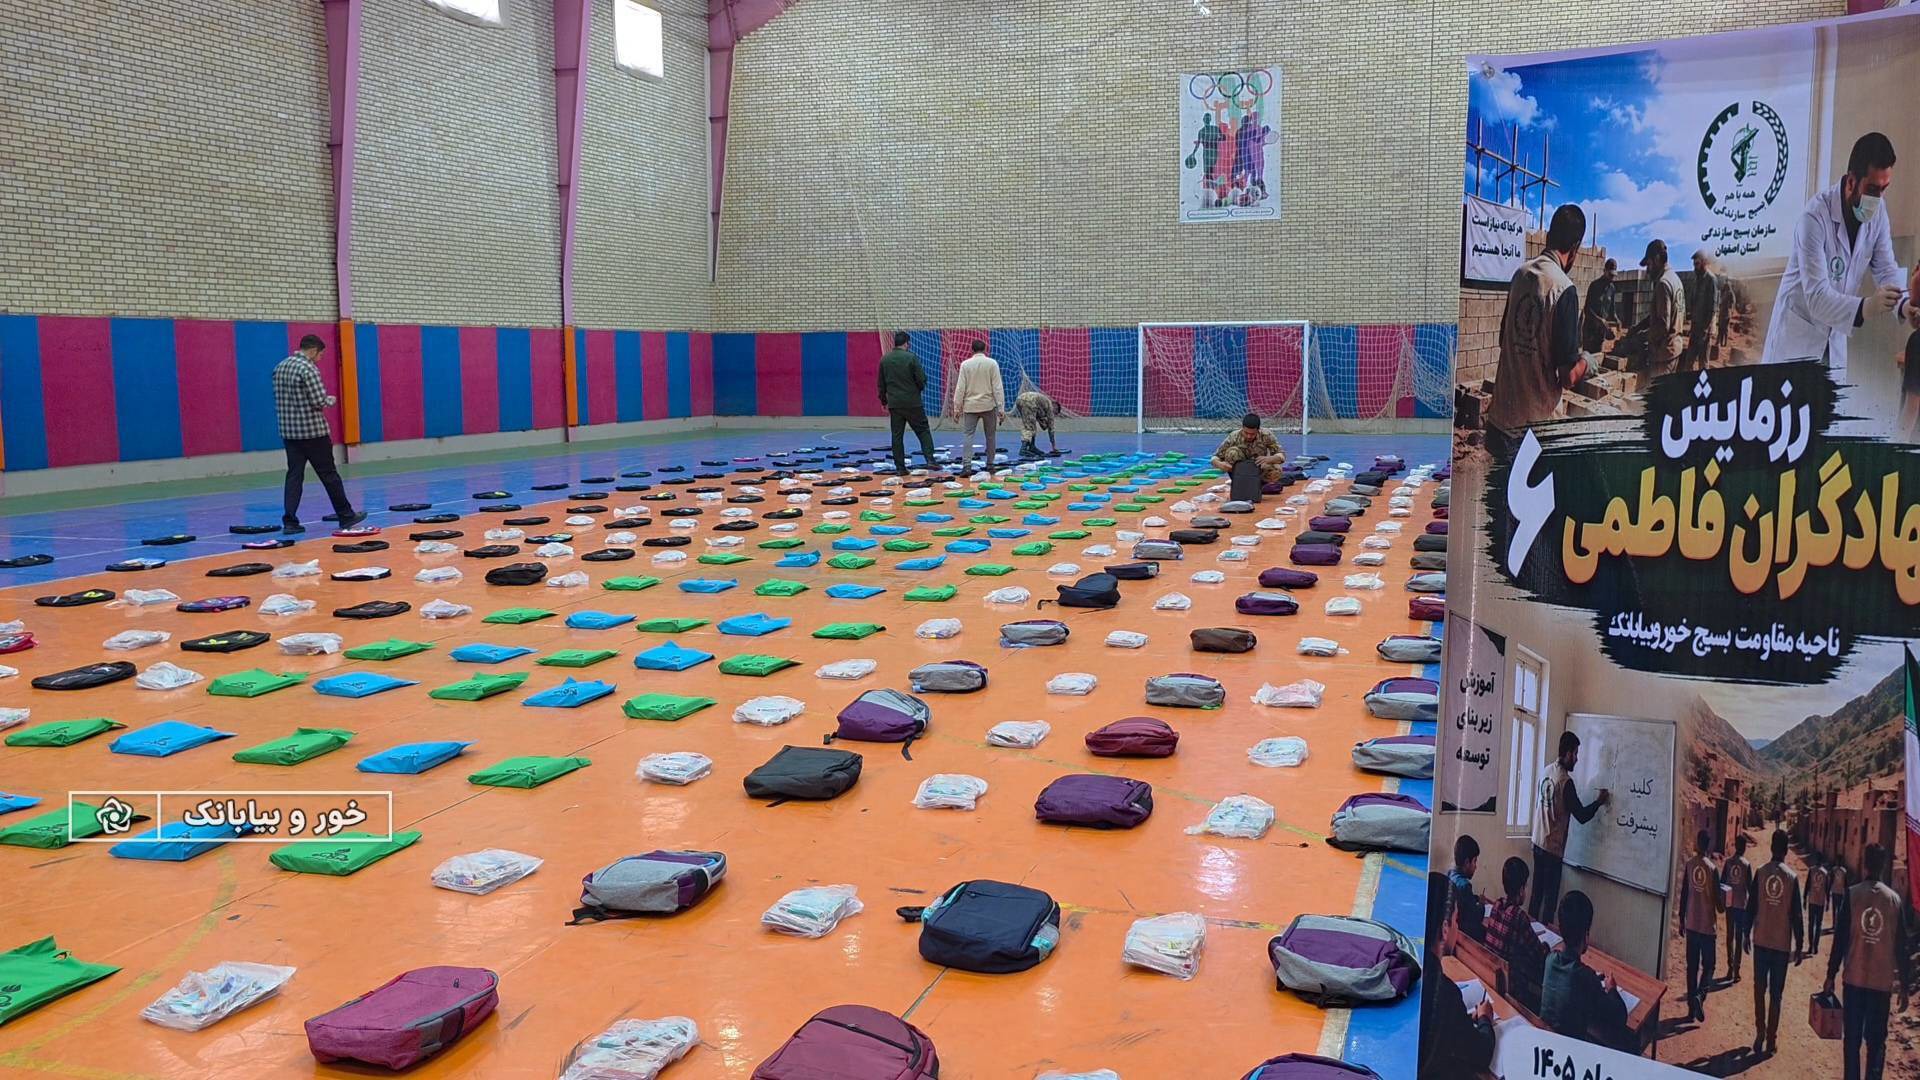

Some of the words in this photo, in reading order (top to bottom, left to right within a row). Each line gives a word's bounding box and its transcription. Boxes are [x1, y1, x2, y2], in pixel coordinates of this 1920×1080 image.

[1724, 192, 1735, 203] هم
[1742, 190, 1756, 198] همه
[1713, 206, 1746, 222] سازندگی
[1748, 201, 1767, 219] بسیج
[1701, 226, 1733, 241] سازندگی
[1733, 228, 1751, 240] بسیج
[1751, 224, 1777, 238] سازمان
[1472, 243, 1500, 257] هستیم
[1501, 243, 1514, 260] آنجا
[1514, 246, 1521, 257] ما
[1715, 243, 1740, 257] اصفهان
[1740, 242, 1760, 256] استان
[1661, 369, 1810, 463] رزمایش
[1507, 427, 1555, 578] ۶
[1562, 457, 1725, 584] فاطمی
[1729, 450, 1920, 605] هادگران
[1692, 626, 1731, 656] بسیج
[1735, 622, 1794, 660] مقاومت
[1796, 627, 1840, 661] ناحیه
[1460, 672, 1496, 697] آموزش
[1456, 746, 1490, 770] توسعه
[1630, 778, 1654, 799] کلید
[1616, 812, 1659, 839] پیشرفت
